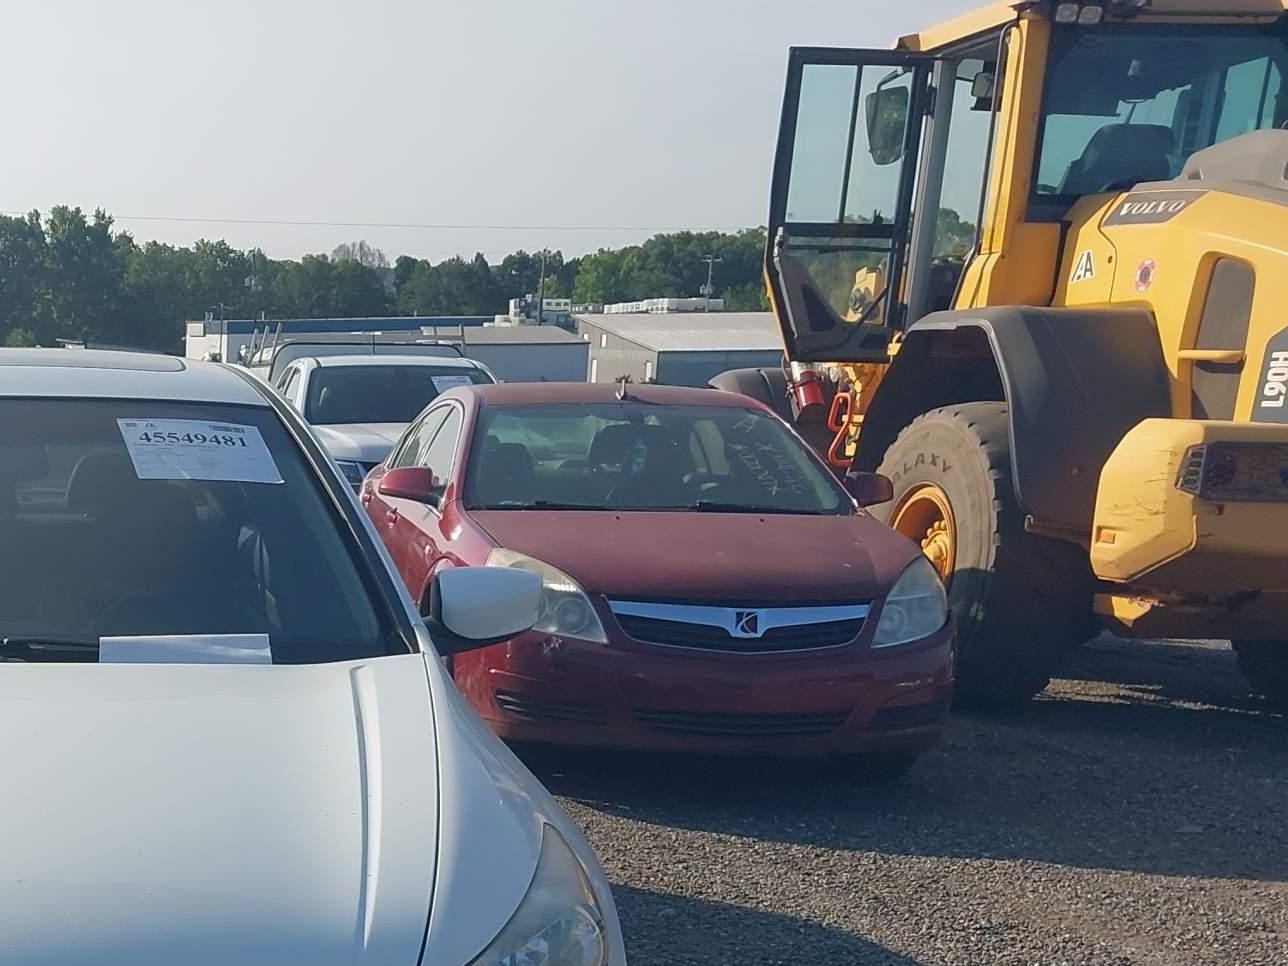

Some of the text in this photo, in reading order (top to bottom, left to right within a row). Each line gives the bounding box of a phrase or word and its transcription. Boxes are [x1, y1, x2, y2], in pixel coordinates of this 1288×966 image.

[1119, 199, 1187, 216] VOLVO
[1260, 351, 1288, 407] L90H
[138, 431, 248, 448] 45549481
[892, 453, 952, 481] ALAXY
